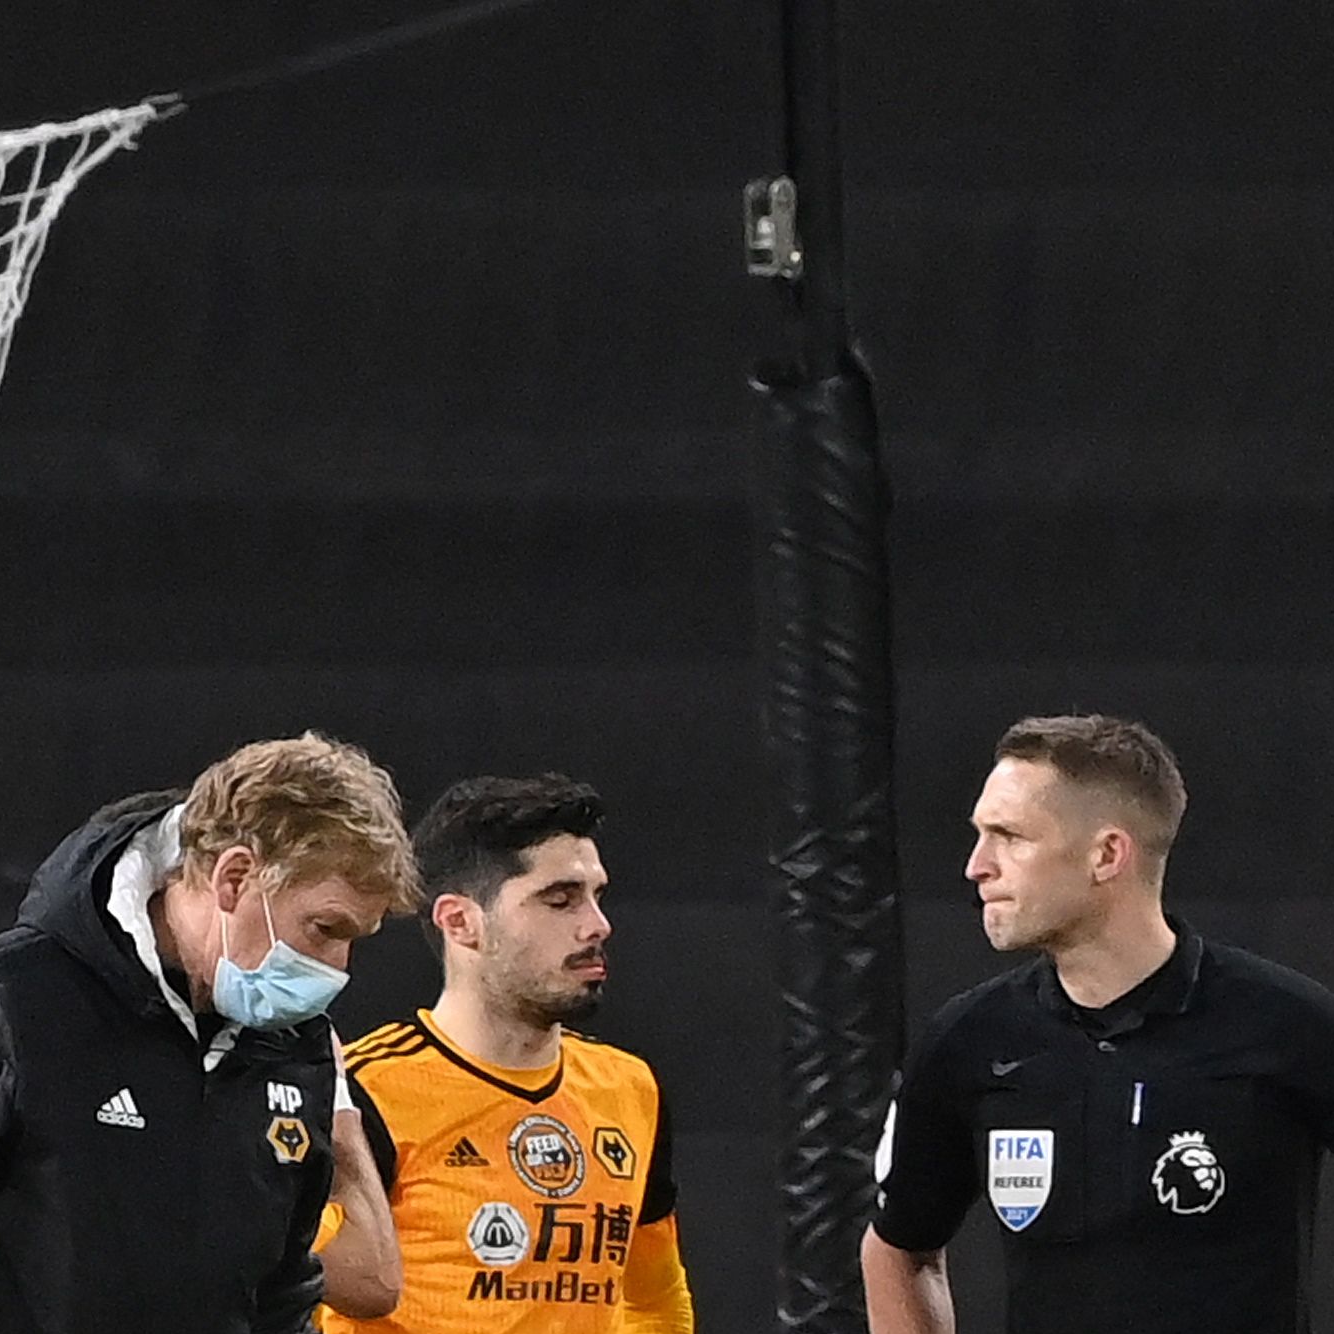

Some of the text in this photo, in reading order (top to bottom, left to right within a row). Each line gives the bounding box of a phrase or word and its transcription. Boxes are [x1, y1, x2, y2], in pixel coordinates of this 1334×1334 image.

[96, 1109, 146, 1129] adidas
[994, 1137, 1044, 1160] FIFA
[994, 1176, 1044, 1189] REFEREE
[533, 1202, 632, 1266] 万博
